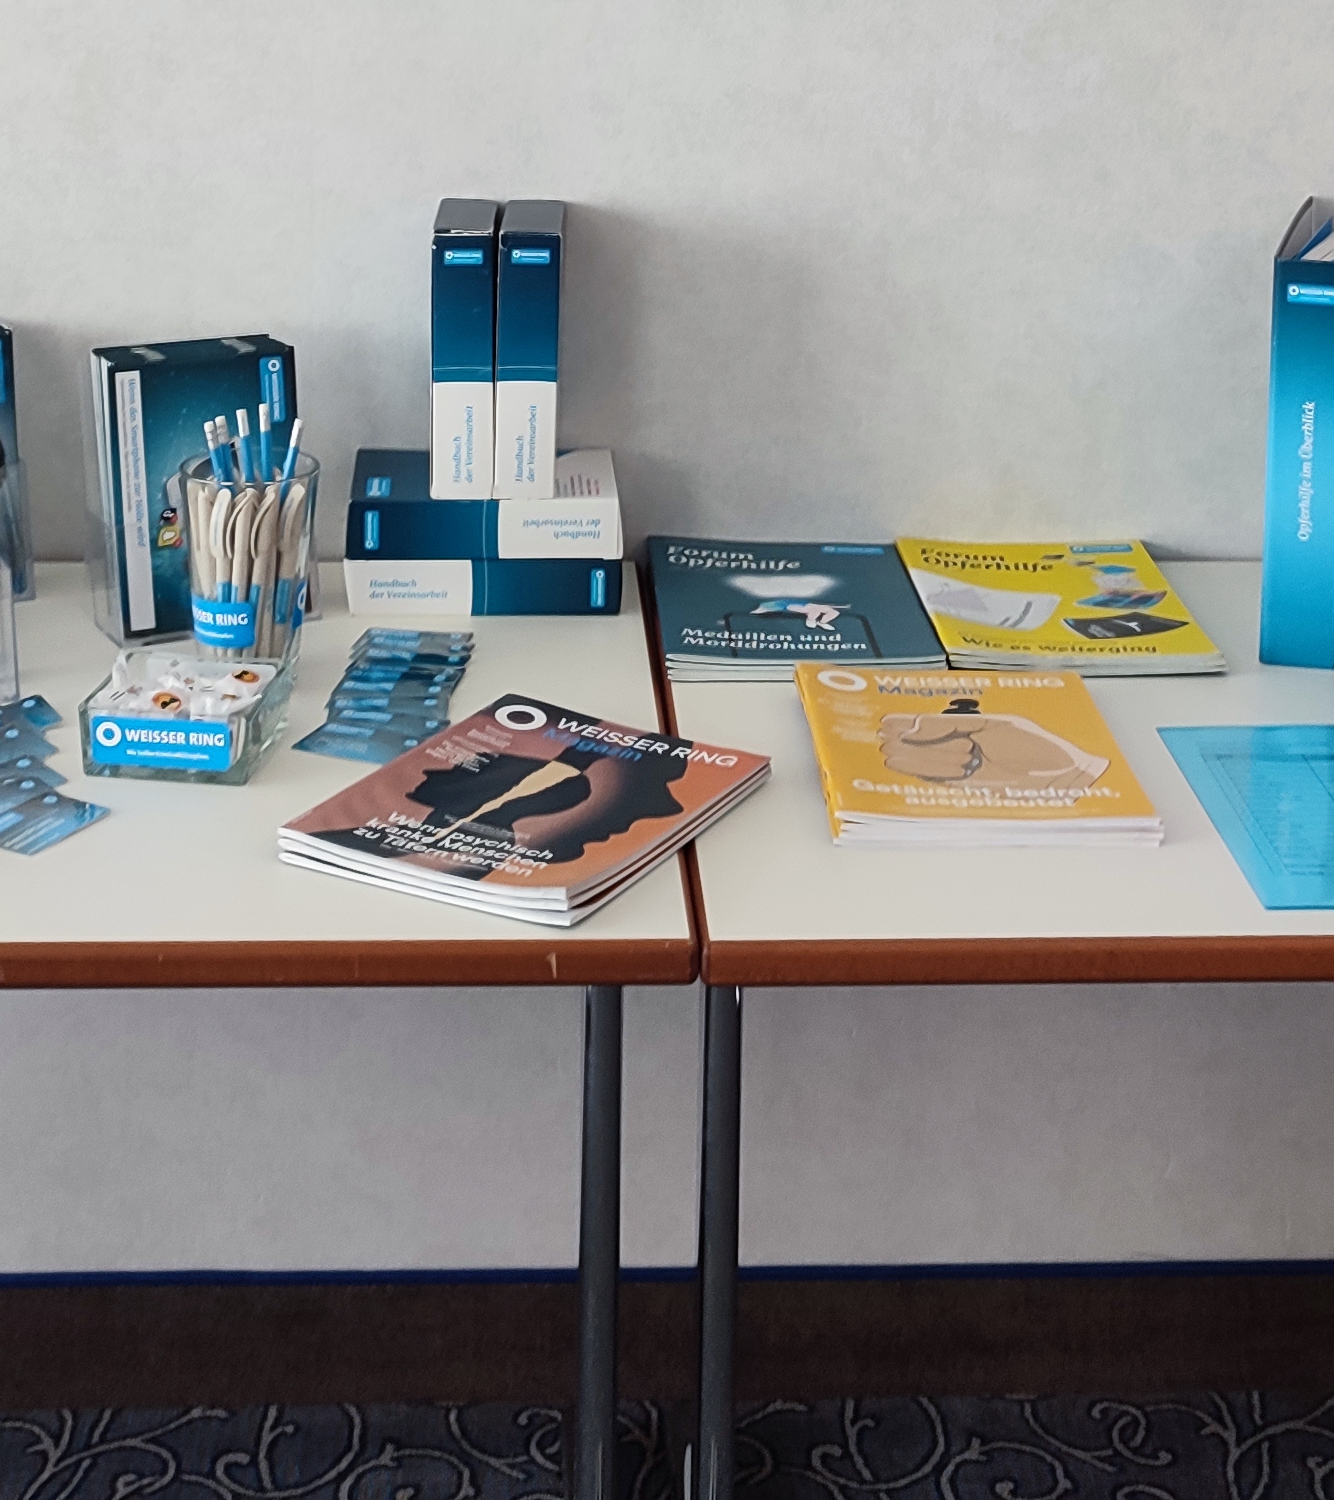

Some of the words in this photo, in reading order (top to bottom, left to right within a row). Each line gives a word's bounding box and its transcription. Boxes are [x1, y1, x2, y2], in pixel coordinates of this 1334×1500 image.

[1298, 401, 1315, 460] Überblick
[1300, 461, 1312, 479] im
[1297, 480, 1314, 542] Opferhilfe
[666, 545, 754, 560] Forum
[668, 554, 801, 571] Opferhilfe
[923, 556, 1053, 572] Opferhilfe
[216, 613, 248, 626] RING
[680, 628, 793, 642] Medaillen
[799, 633, 842, 642] und
[682, 636, 867, 651] Morddrohungen
[873, 675, 992, 688] WEISSER
[997, 676, 1066, 688] RING
[878, 685, 984, 697] Magazin
[125, 728, 186, 746] WEISSER
[189, 732, 225, 747] RING
[542, 728, 643, 762] Magazin
[557, 717, 670, 755] WEISSER
[671, 746, 739, 768] RING
[365, 817, 437, 843] kranke
[436, 839, 549, 870] Menschen
[388, 811, 444, 835] Wenn
[447, 831, 554, 860] psychisch
[352, 827, 382, 840] zu
[452, 851, 533, 878] werden
